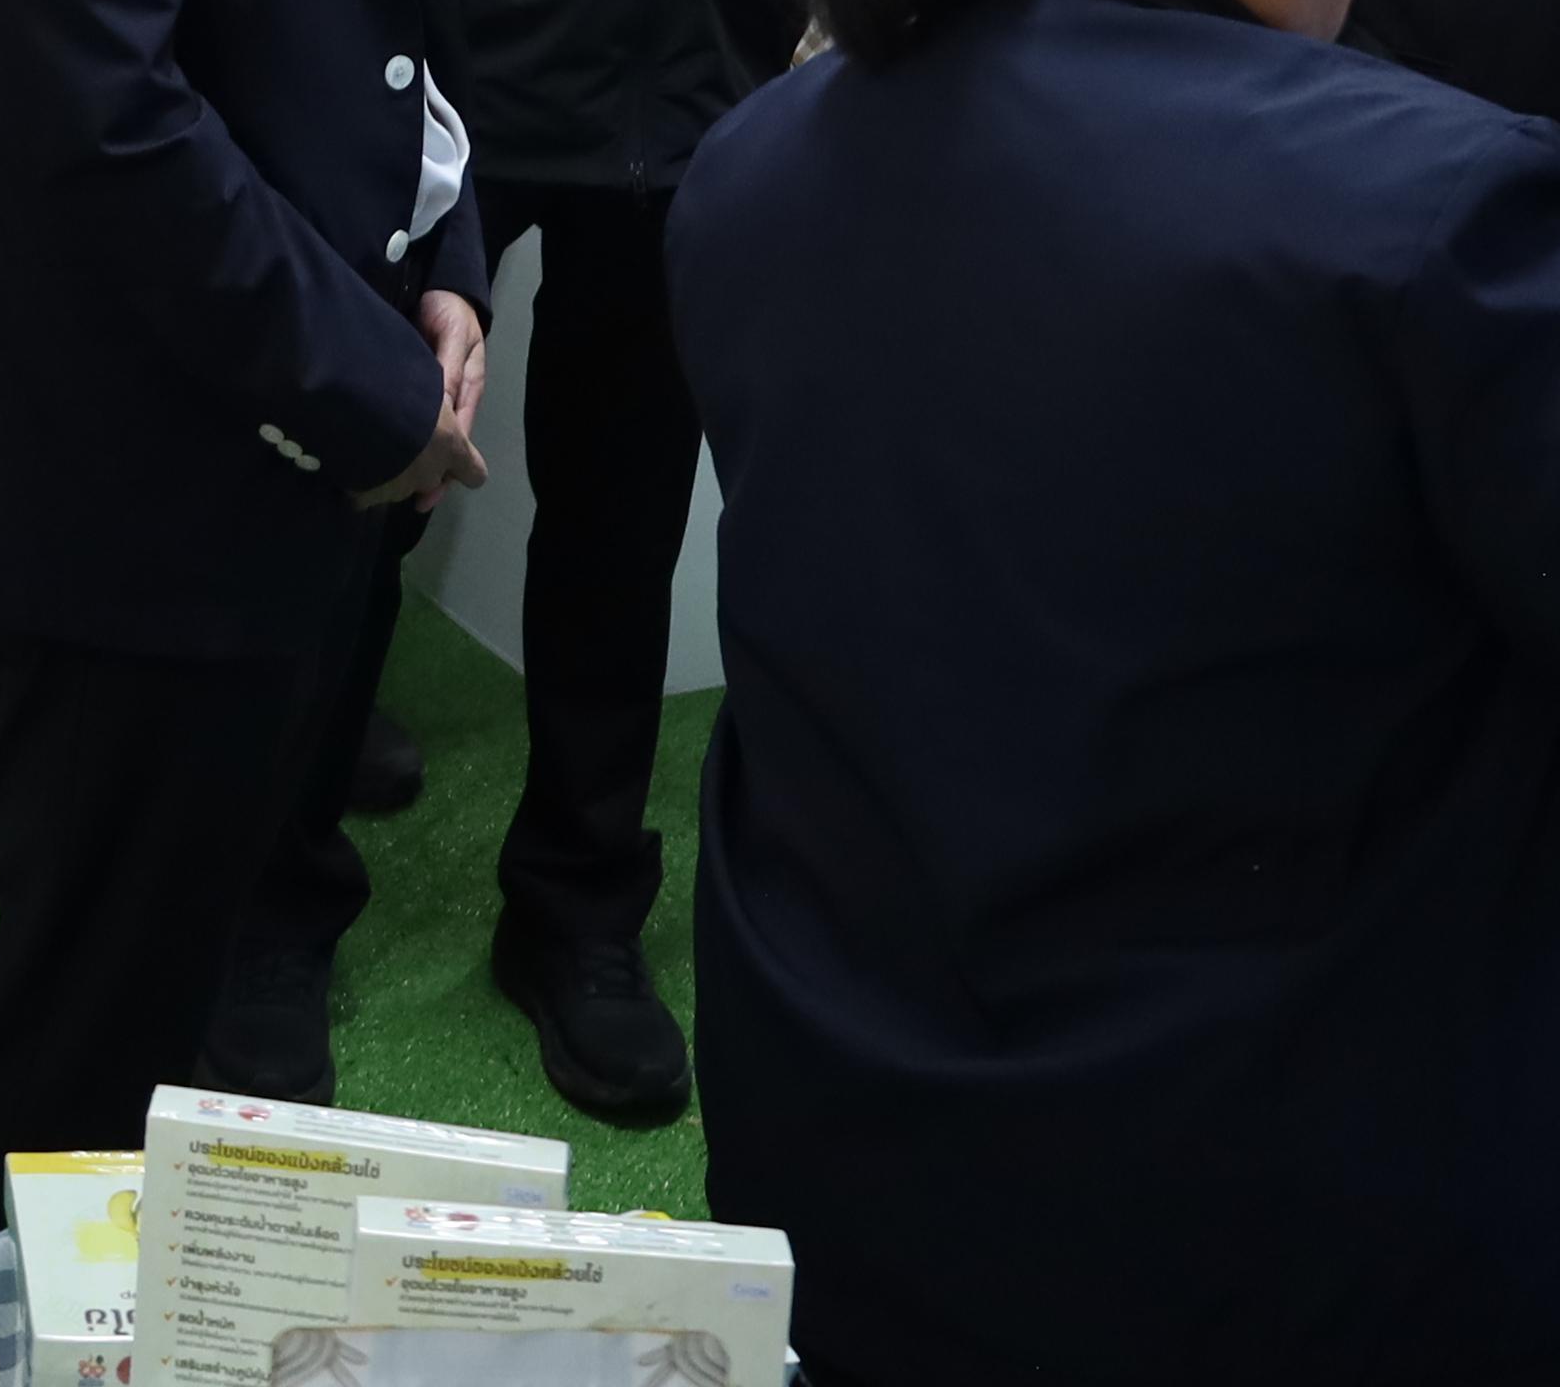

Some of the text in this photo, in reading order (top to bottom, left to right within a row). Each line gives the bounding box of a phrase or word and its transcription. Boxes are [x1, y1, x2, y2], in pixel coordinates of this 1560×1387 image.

[188, 1137, 381, 1179] ประโยชน์ของแป้งกล้วยไข่
[401, 1250, 604, 1284] ประโยชน์ของแป้งกล้วยไข่
